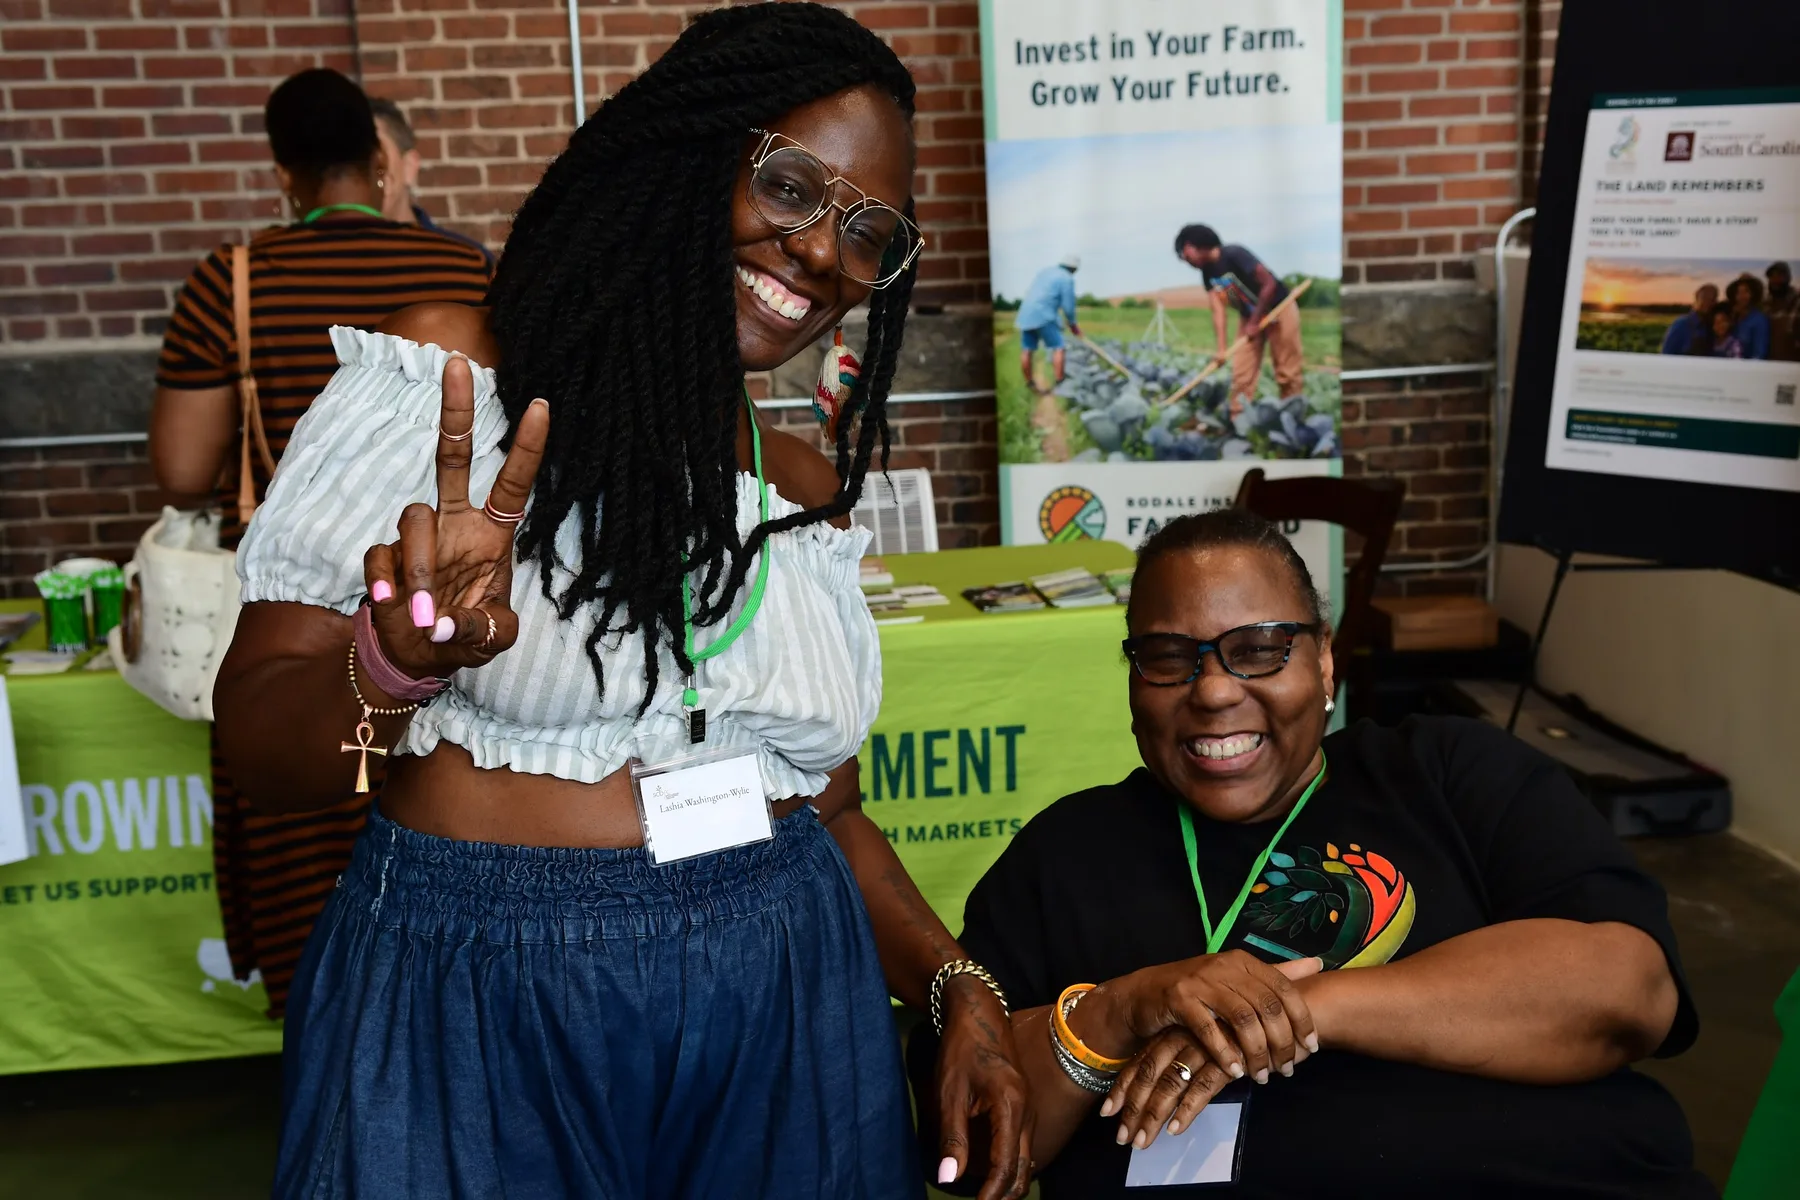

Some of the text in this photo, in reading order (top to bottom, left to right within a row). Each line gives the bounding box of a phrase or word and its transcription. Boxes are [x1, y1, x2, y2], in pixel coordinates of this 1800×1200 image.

[1015, 25, 1304, 65] Invest in Your Farm.
[1031, 71, 1290, 106] Grow Your Future.
[1700, 141, 1744, 156] South
[1597, 178, 1765, 192] THE LAND REMEMBERS
[859, 725, 1026, 802] MENT
[659, 802, 684, 814] Lashia
[906, 818, 1023, 843] MARKETS
[0, 872, 213, 905] ET US SUPPORT
